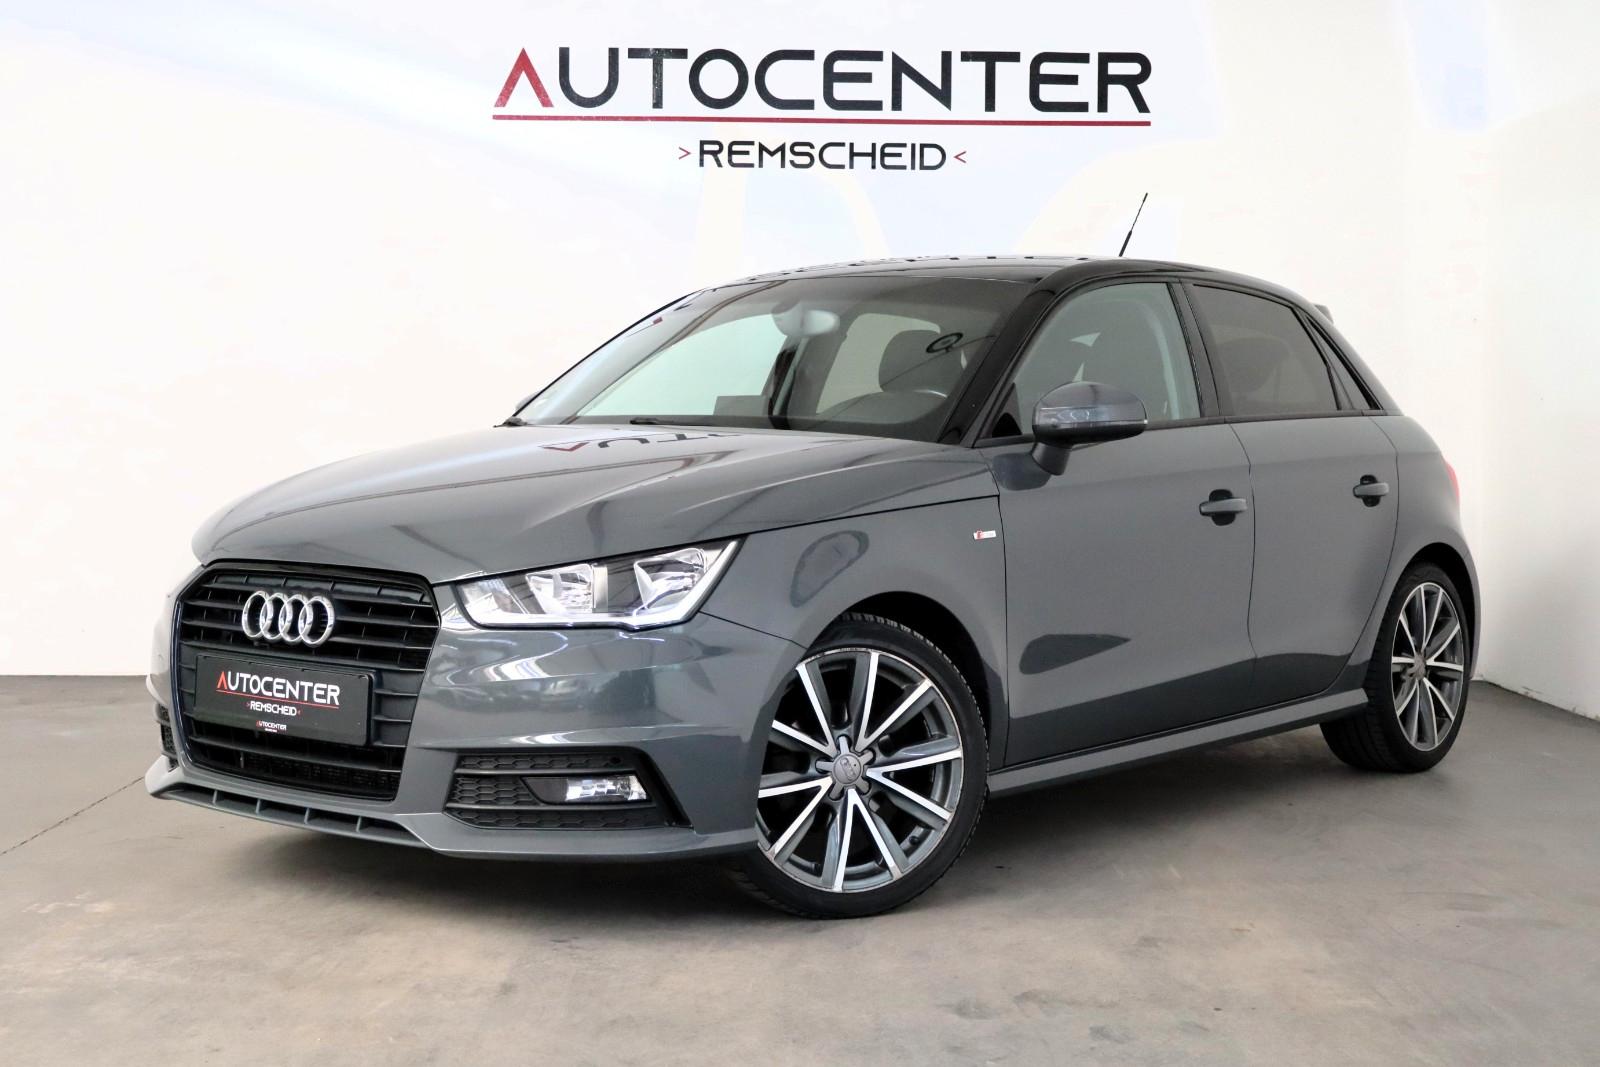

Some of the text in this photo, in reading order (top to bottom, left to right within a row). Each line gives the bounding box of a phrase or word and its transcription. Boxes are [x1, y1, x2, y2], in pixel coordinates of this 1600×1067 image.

[494, 46, 1151, 113] AUTOCENTER
[699, 140, 946, 171] REMSCHEID
[217, 671, 340, 705] AUTOCENTER
[250, 700, 297, 716] REMSCHEID
